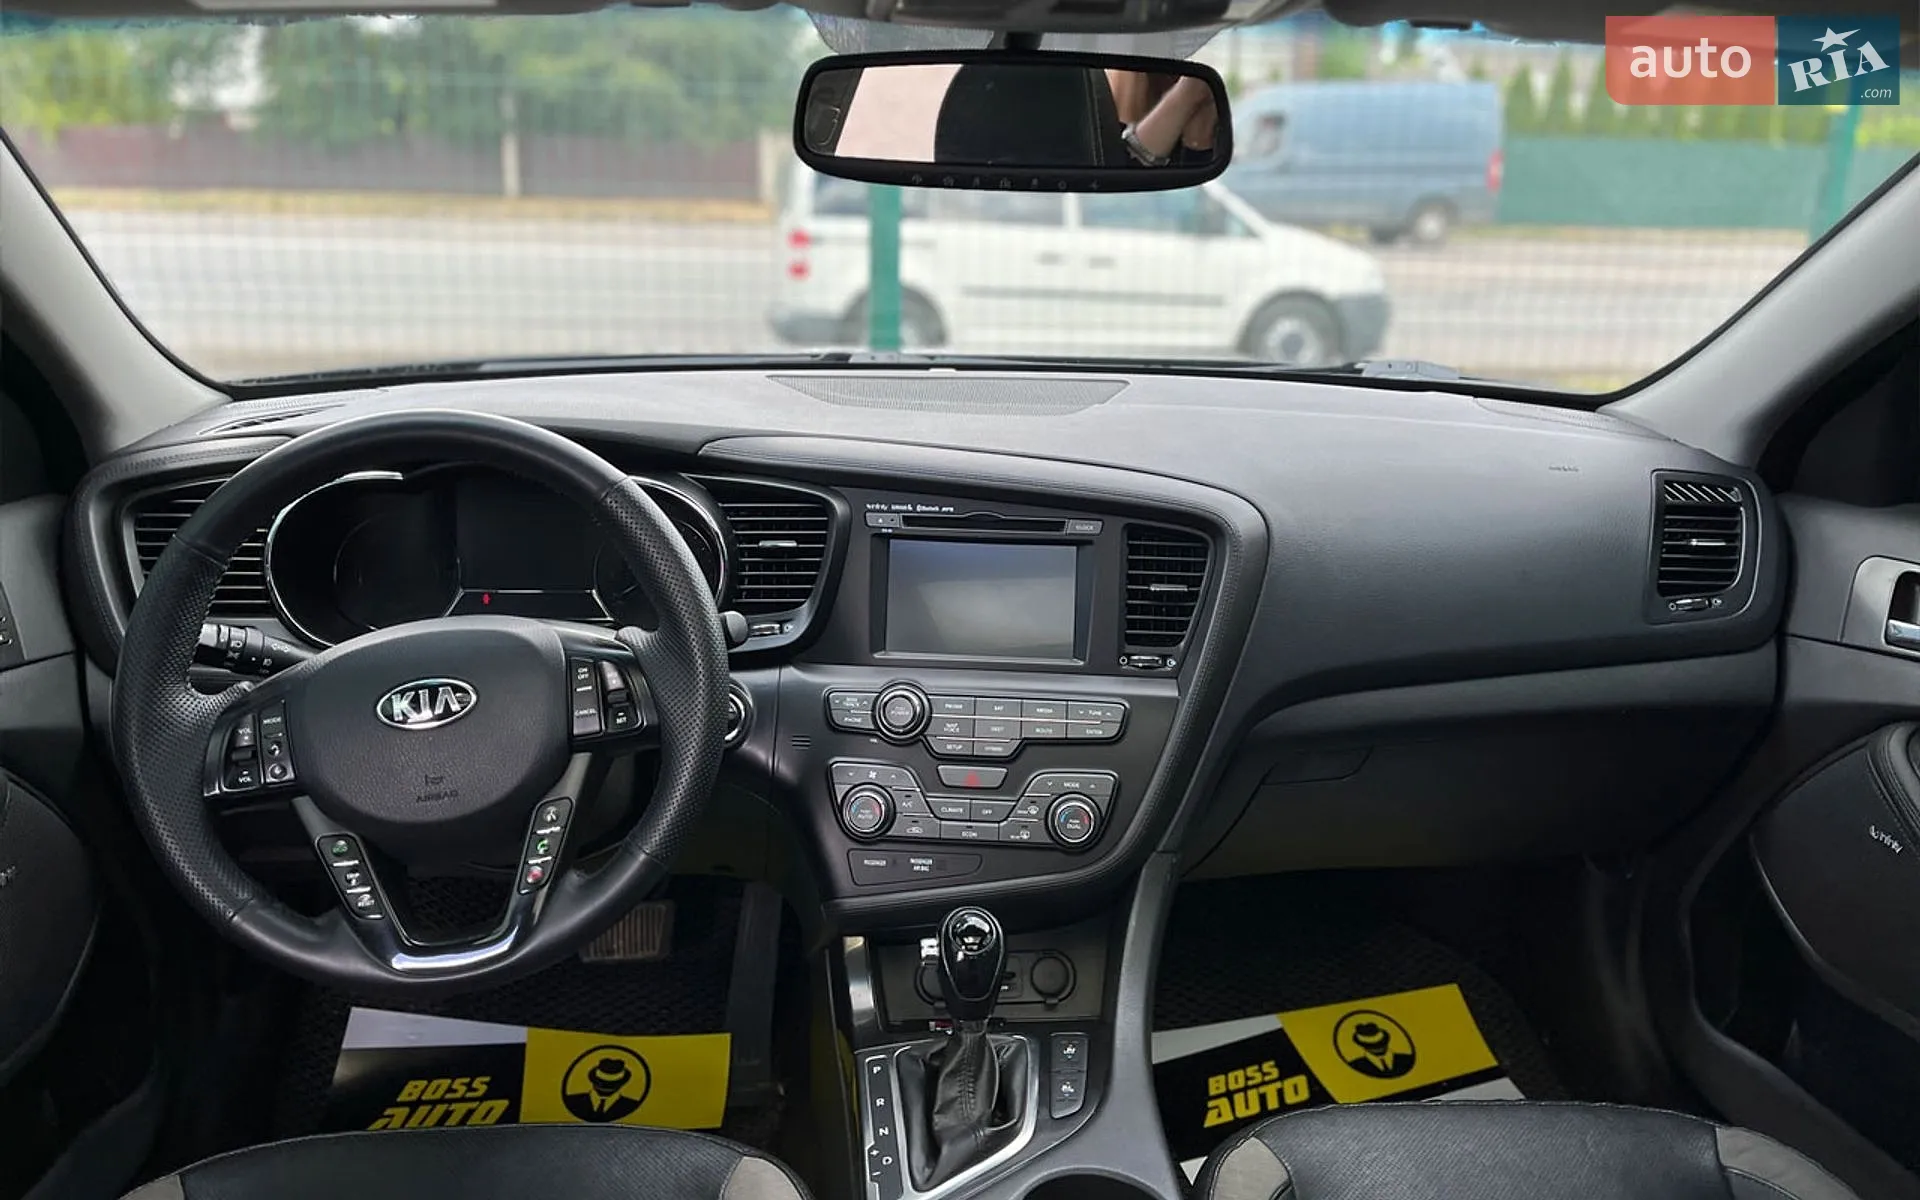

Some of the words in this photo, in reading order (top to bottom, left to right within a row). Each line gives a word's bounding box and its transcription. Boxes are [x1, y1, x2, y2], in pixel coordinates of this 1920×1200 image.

[391, 686, 462, 723] KIA
[872, 1065, 882, 1075] P
[1207, 1060, 1280, 1097] BOSS
[396, 1076, 492, 1102] BOSS
[875, 1098, 885, 1107] R
[1203, 1074, 1310, 1128] AUTO
[367, 1099, 510, 1131] AUTO
[879, 1126, 889, 1136] N
